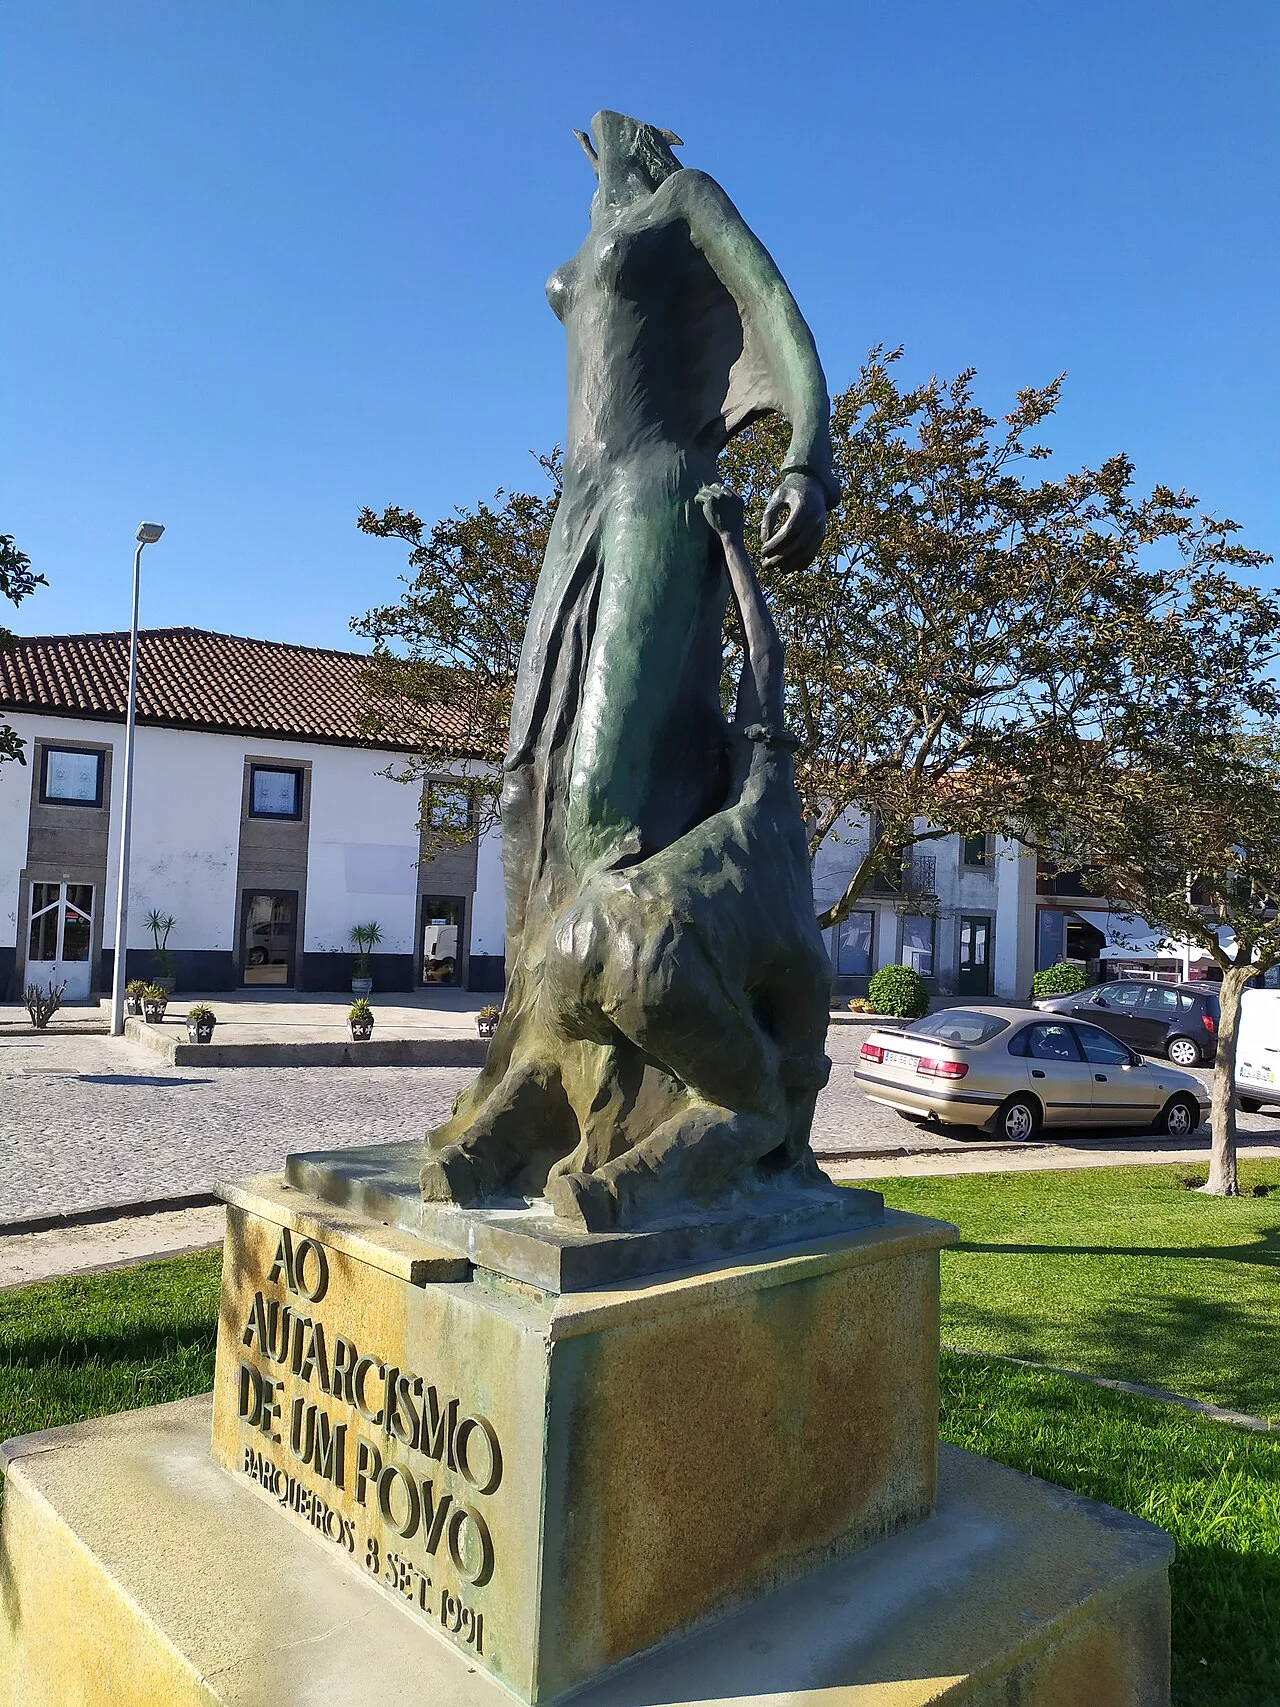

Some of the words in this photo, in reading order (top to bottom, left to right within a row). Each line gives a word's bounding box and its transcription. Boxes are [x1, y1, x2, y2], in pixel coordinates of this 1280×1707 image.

[267, 1227, 329, 1303] AO
[238, 1360, 284, 1444] DE
[290, 1397, 347, 1490] UM
[355, 1434, 494, 1587] POVO
[242, 1291, 503, 1495] AUTARCISMO
[243, 1443, 355, 1553] BARQUEIROS
[366, 1537, 379, 1574] 8
[385, 1551, 432, 1614] SET.
[441, 1589, 484, 1656] 1991
